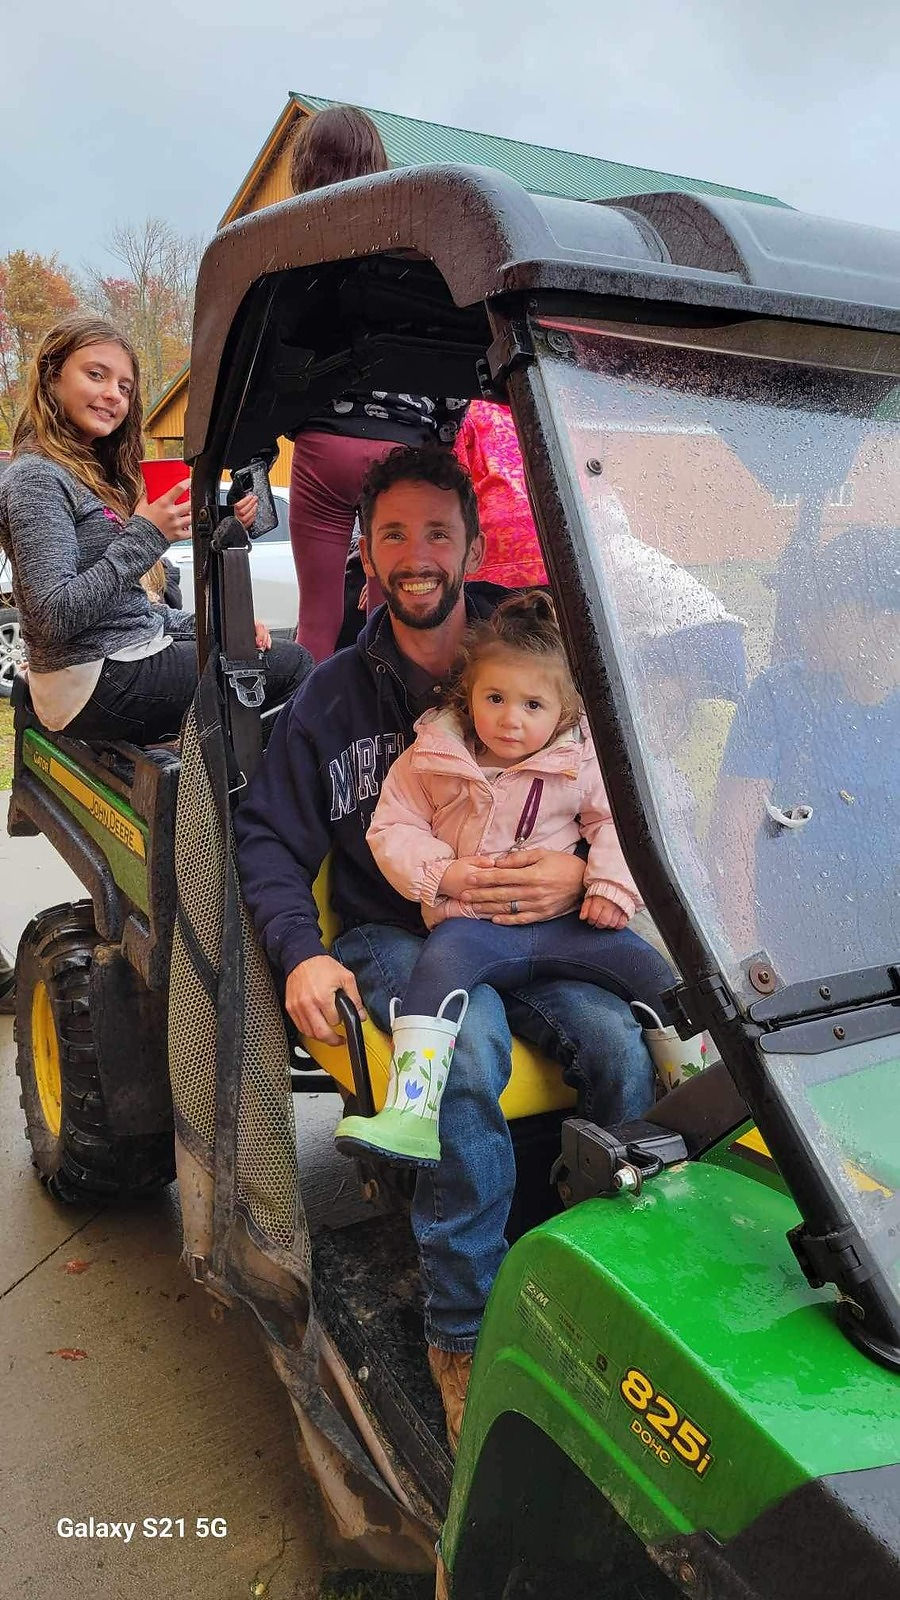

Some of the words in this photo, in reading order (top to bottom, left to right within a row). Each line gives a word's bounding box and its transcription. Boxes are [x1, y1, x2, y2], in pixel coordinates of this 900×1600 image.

[89, 795, 109, 826] JOHN
[108, 810, 134, 849] DEERE
[621, 1370, 711, 1474] 825i
[631, 1419, 671, 1464] DOHC
